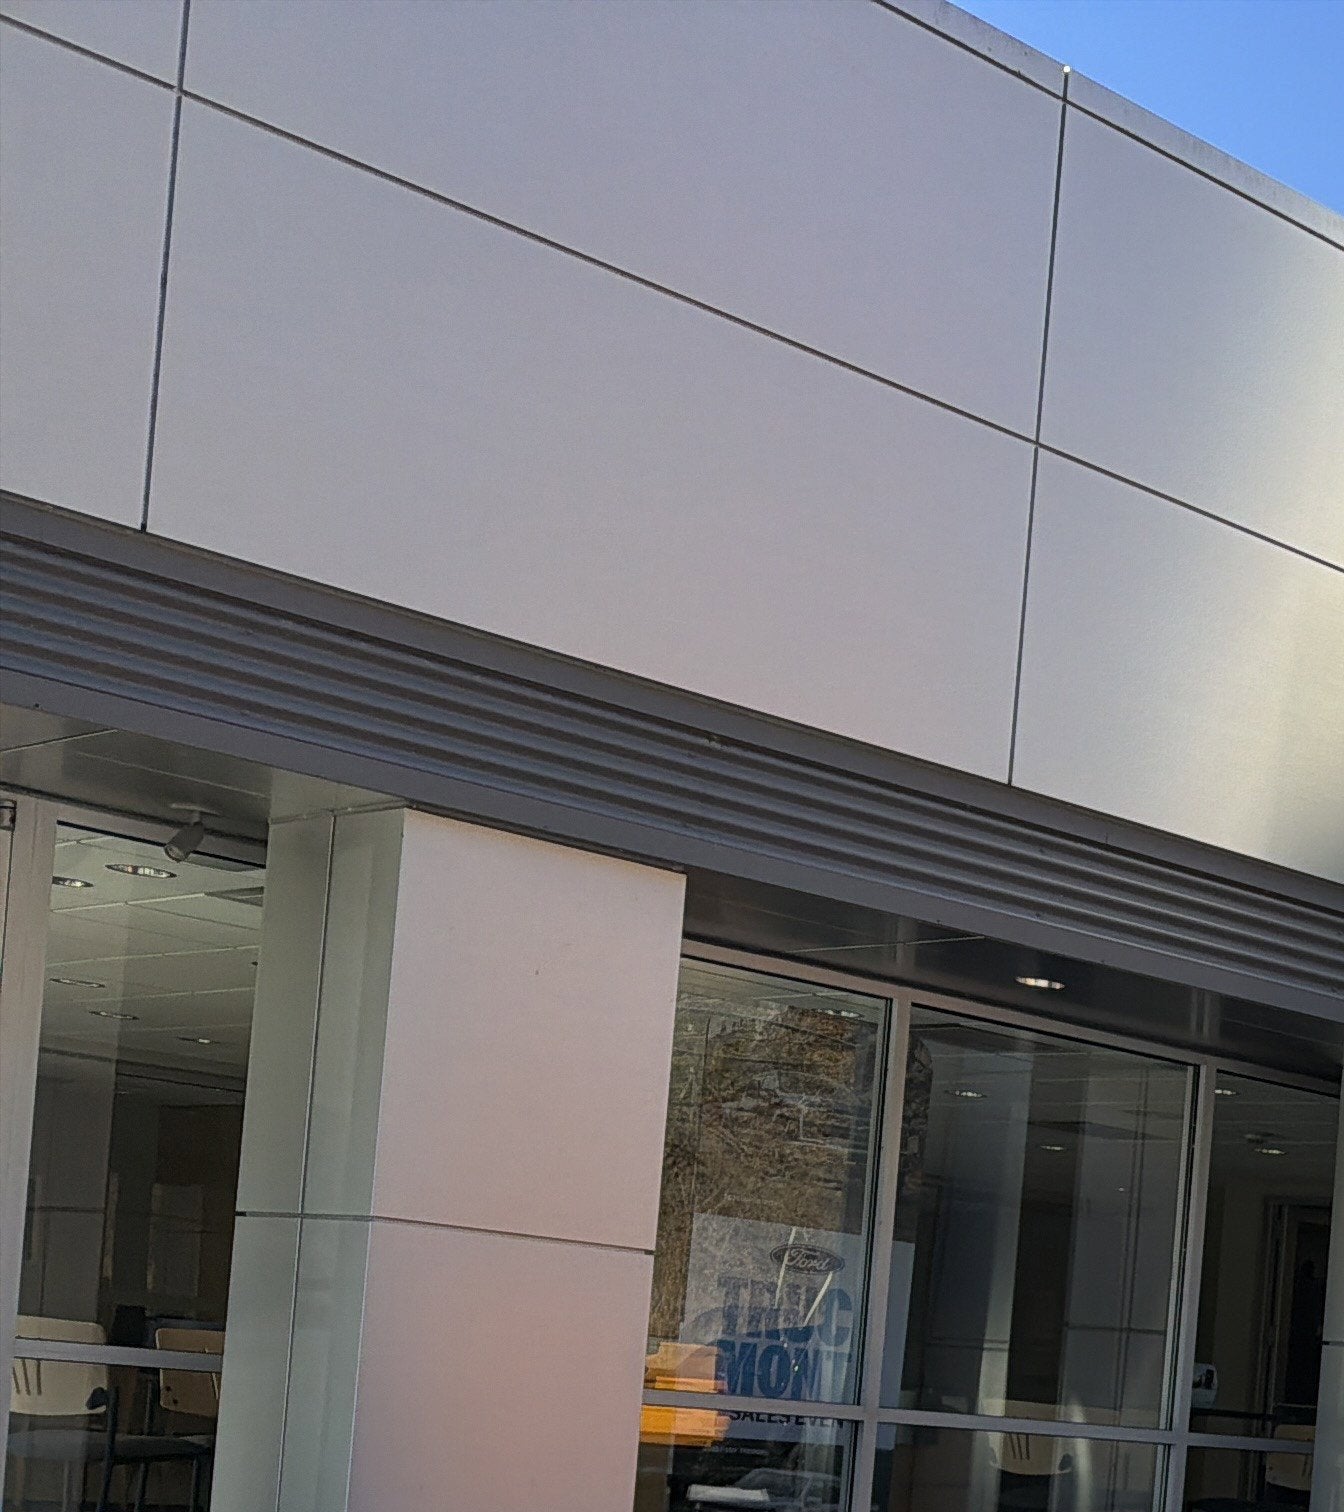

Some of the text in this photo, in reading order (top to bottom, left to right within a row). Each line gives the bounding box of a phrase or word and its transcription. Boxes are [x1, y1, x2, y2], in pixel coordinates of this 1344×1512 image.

[785, 1248, 830, 1272] Ford
[717, 1276, 853, 1347] TRUC
[714, 1339, 852, 1403] MONT
